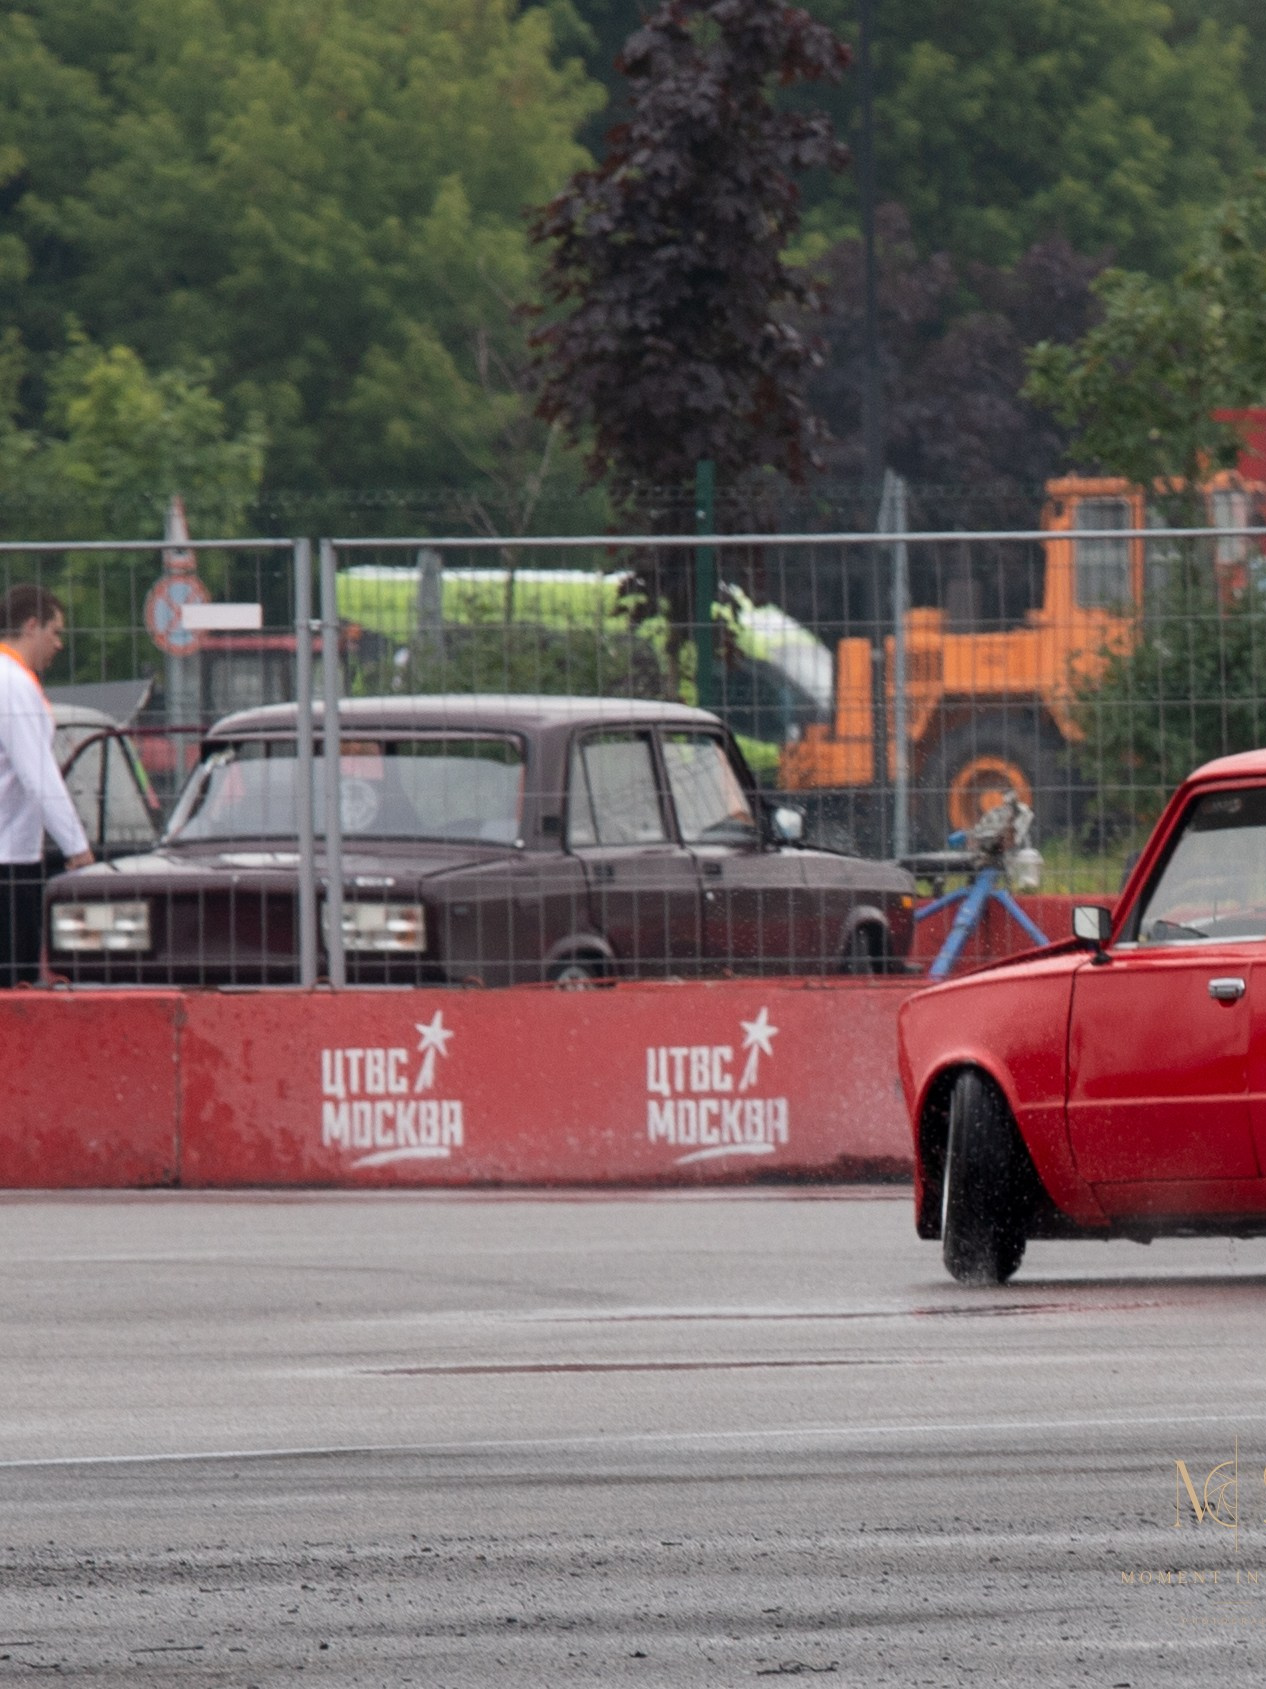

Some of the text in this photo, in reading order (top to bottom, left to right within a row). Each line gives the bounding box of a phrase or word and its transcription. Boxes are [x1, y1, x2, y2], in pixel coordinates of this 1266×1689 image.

[321, 1048, 410, 1098] ЦТВС
[646, 1045, 734, 1097] ЦТВС
[322, 1100, 464, 1148] МОСКВА
[647, 1098, 789, 1145] МОСКВА
